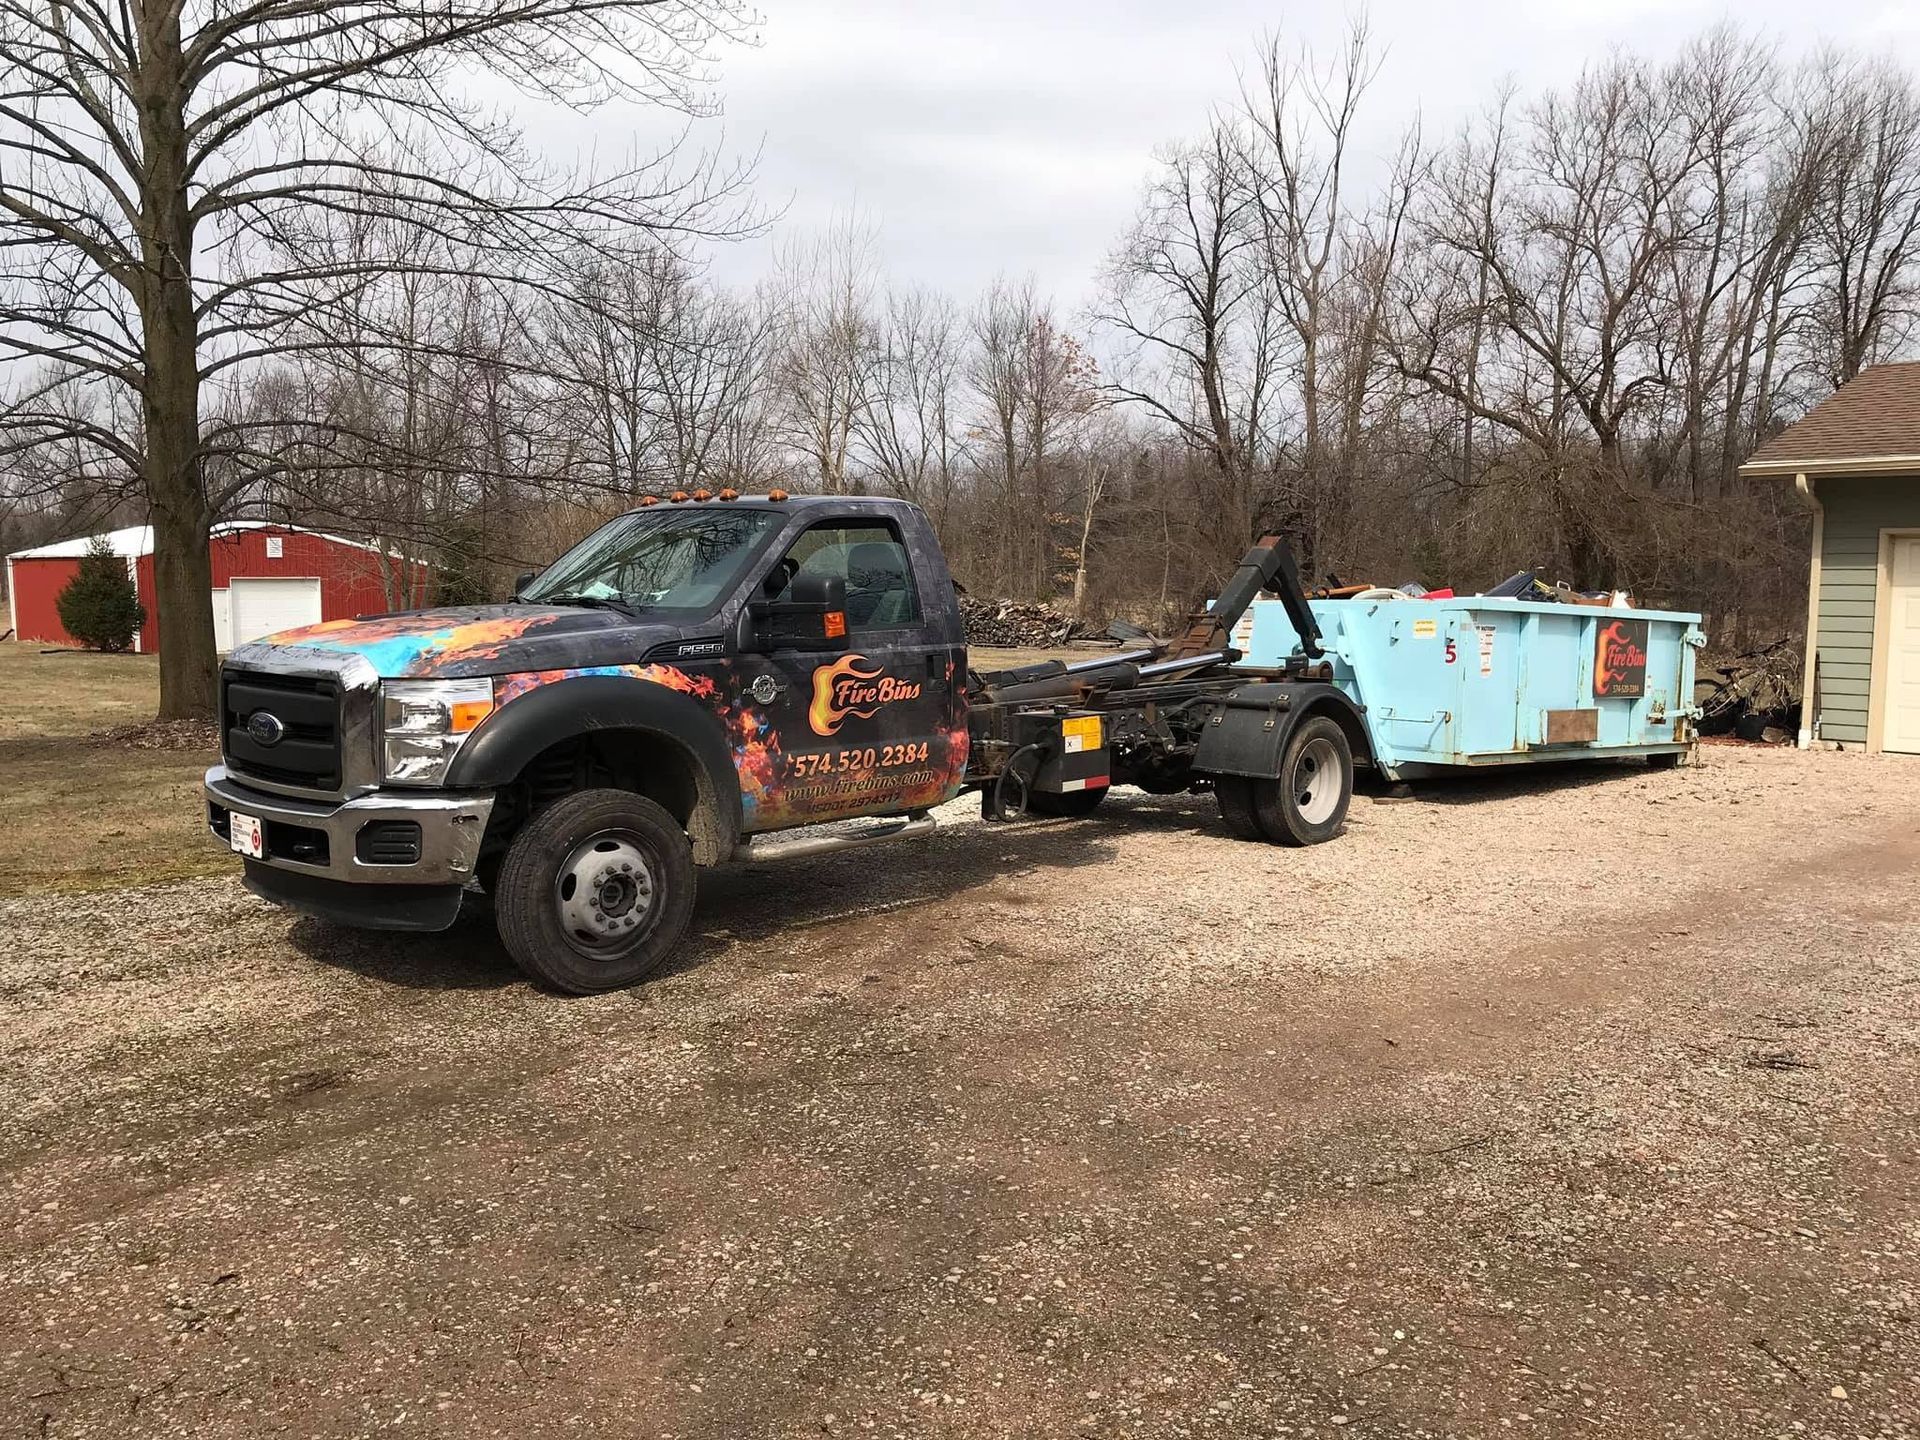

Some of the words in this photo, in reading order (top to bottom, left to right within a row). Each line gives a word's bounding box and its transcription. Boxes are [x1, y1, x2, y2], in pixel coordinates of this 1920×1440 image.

[1444, 644, 1457, 664] 5
[793, 741, 929, 777] 574.520.2384
[782, 768, 933, 803] www.firebins.com
